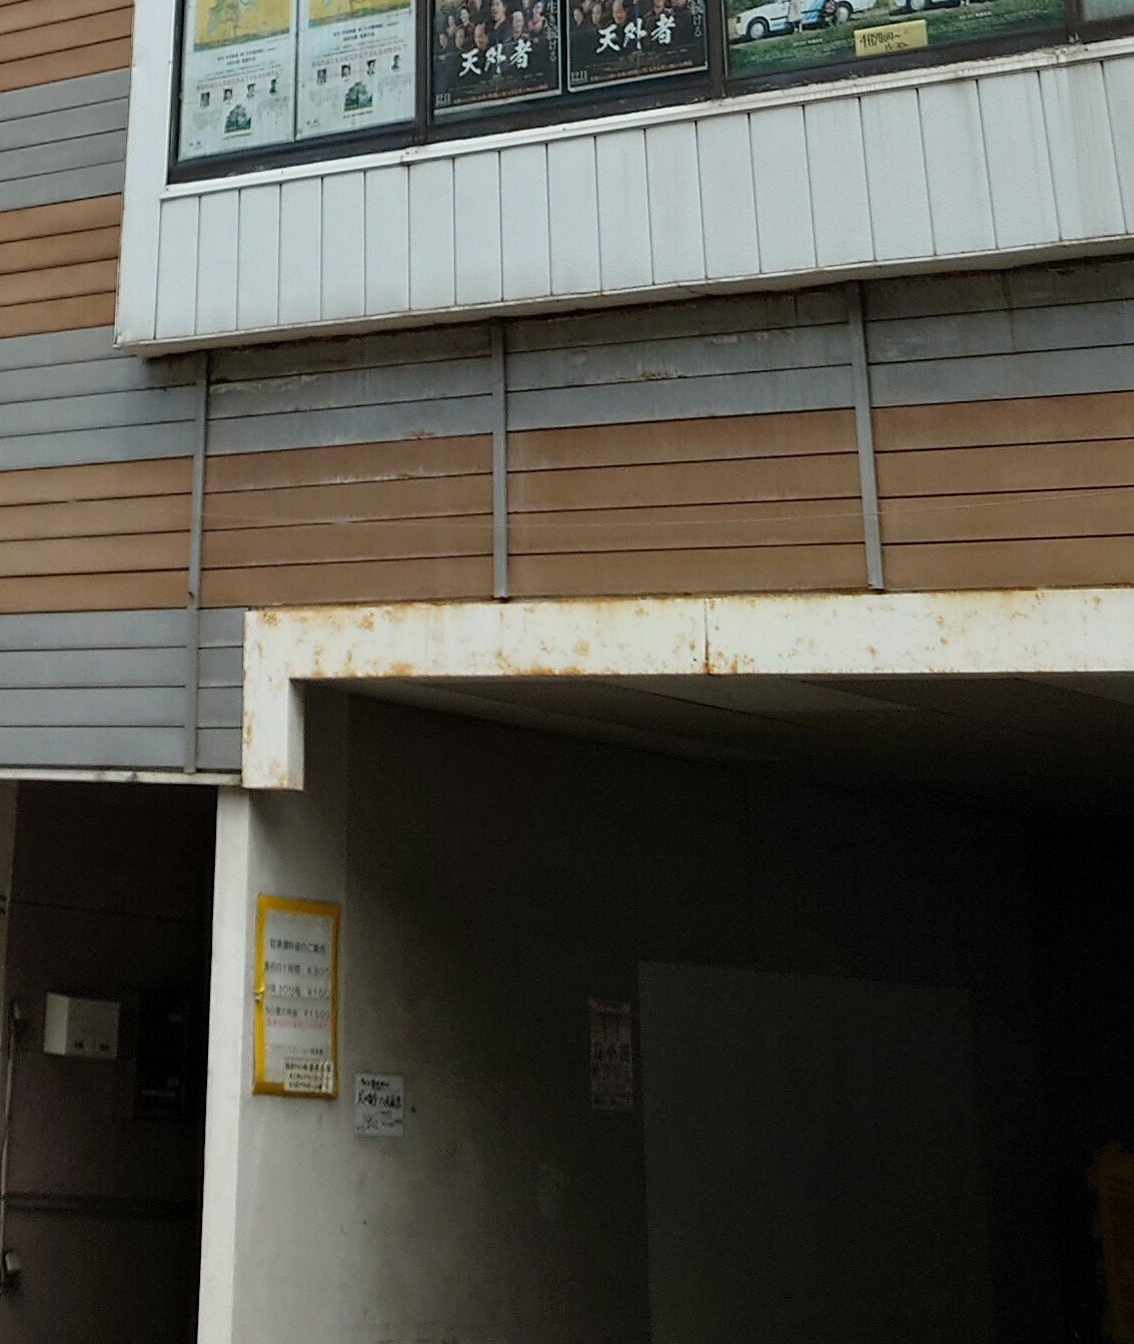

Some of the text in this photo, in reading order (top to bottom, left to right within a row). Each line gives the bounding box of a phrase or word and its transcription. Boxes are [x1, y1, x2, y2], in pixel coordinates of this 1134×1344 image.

[596, 15, 676, 54] 天外者
[459, 38, 533, 77] 天外者
